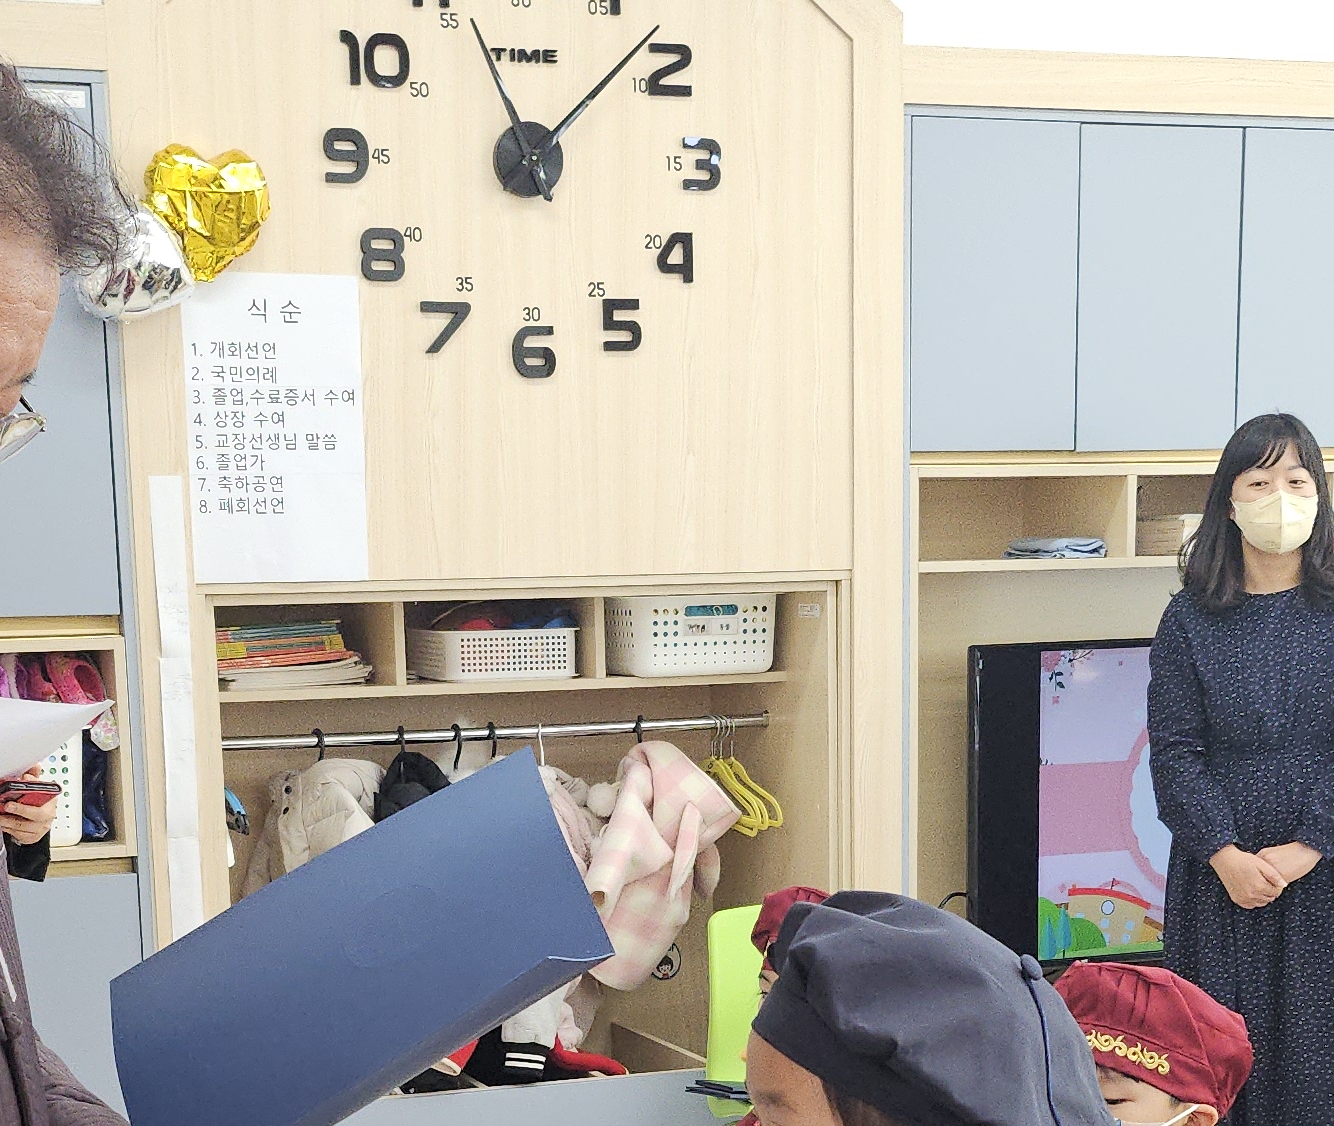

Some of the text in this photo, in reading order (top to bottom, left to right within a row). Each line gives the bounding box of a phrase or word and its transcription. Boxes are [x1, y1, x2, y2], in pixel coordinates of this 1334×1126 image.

[440, 13, 459, 29] 55
[339, 29, 410, 89] 10
[490, 47, 558, 64] TIME
[648, 42, 692, 97] 2
[409, 82, 430, 98] 50
[632, 77, 649, 94] 10
[322, 128, 369, 183] 9
[371, 148, 390, 165] 45
[665, 155, 682, 172] 15
[682, 136, 721, 191] 3
[404, 226, 422, 243] 40
[645, 234, 663, 250] 20
[360, 227, 406, 282] 8
[656, 231, 694, 283] 4
[455, 276, 474, 292] 35
[587, 282, 606, 298] 25
[248, 299, 301, 323] 식 순
[522, 307, 541, 322] 30
[420, 301, 471, 353] 7
[602, 298, 642, 351] 5
[191, 341, 277, 360] 1. 개회선언
[512, 325, 556, 379] 6
[191, 366, 278, 384] 2. 국민의례
[193, 388, 355, 406] 3. 졸업,수료증서 수여
[194, 411, 285, 428] 4. 상장 수여
[195, 433, 338, 450] 5. 교장선생님 말씀
[196, 454, 265, 471] 6. 졸업가
[198, 475, 284, 493] 7. 축하공연
[199, 497, 285, 515] 8. 폐회선언
